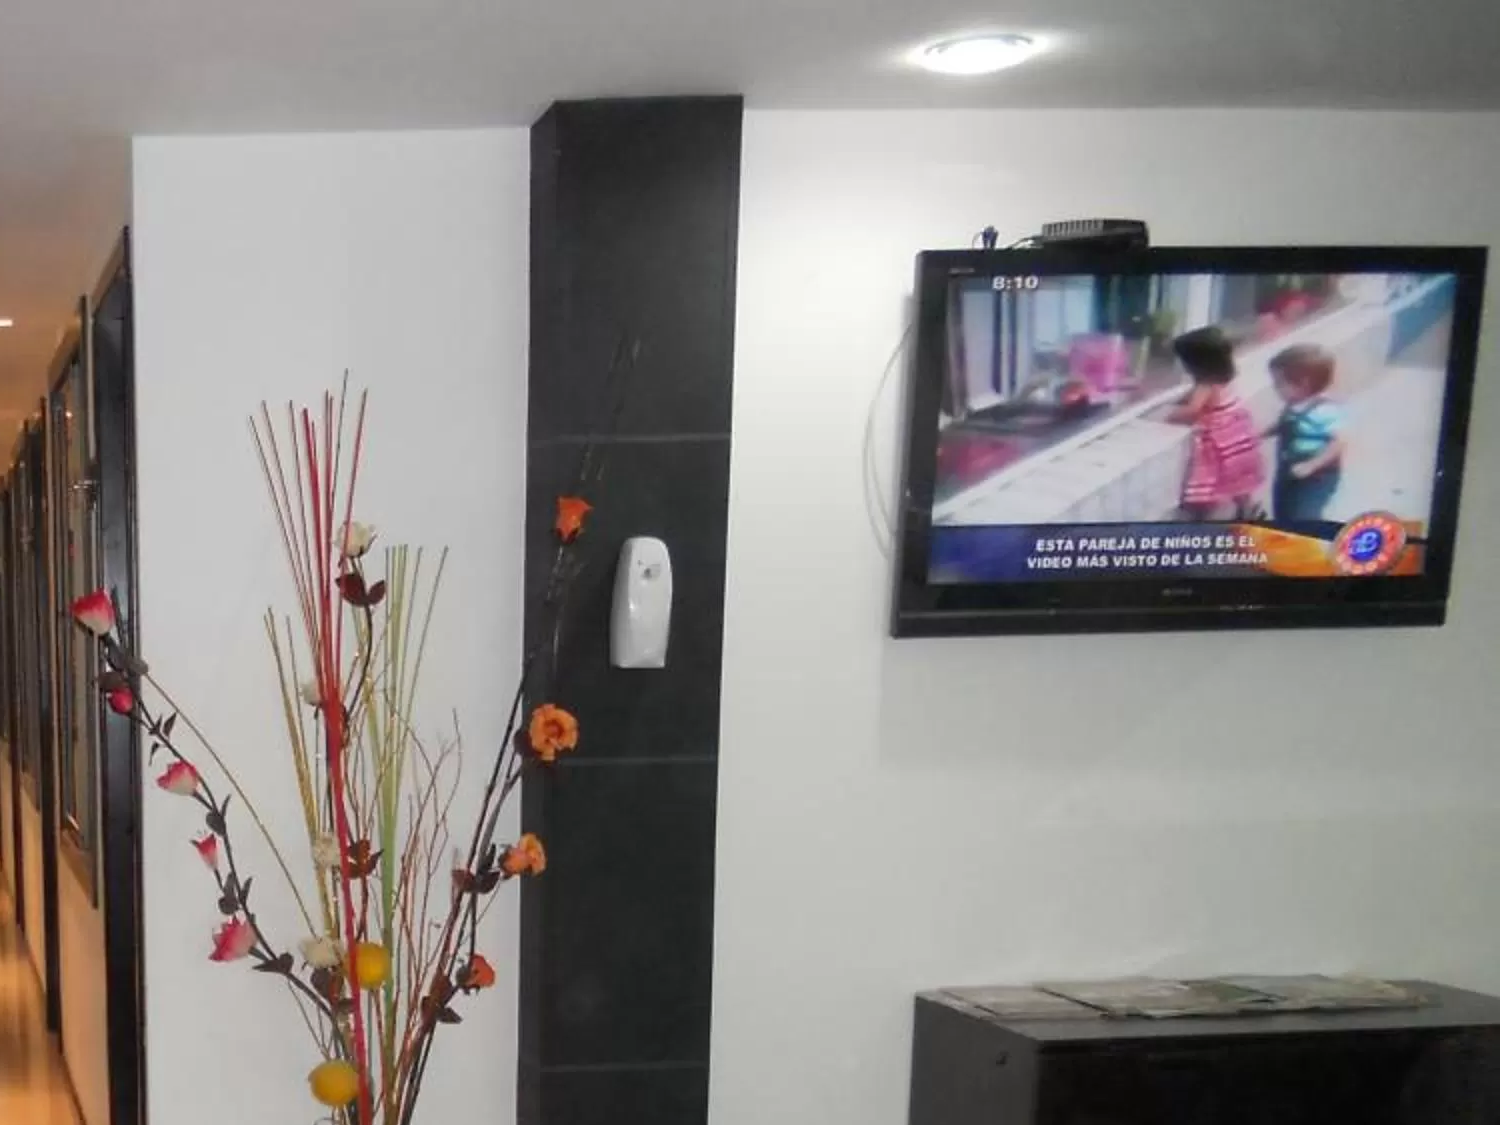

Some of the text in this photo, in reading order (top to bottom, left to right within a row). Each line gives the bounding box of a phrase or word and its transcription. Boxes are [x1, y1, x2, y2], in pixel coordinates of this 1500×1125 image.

[992, 275, 1039, 289] 8:10
[1035, 535, 1256, 552] ESTA PAREJA DE NIÑOS ES EL
[1027, 555, 1072, 569] VIDEO
[1112, 554, 1157, 567] VISTO
[1161, 554, 1181, 566] DE
[1184, 553, 1203, 565] LA
[1207, 553, 1268, 566] SEMANA
